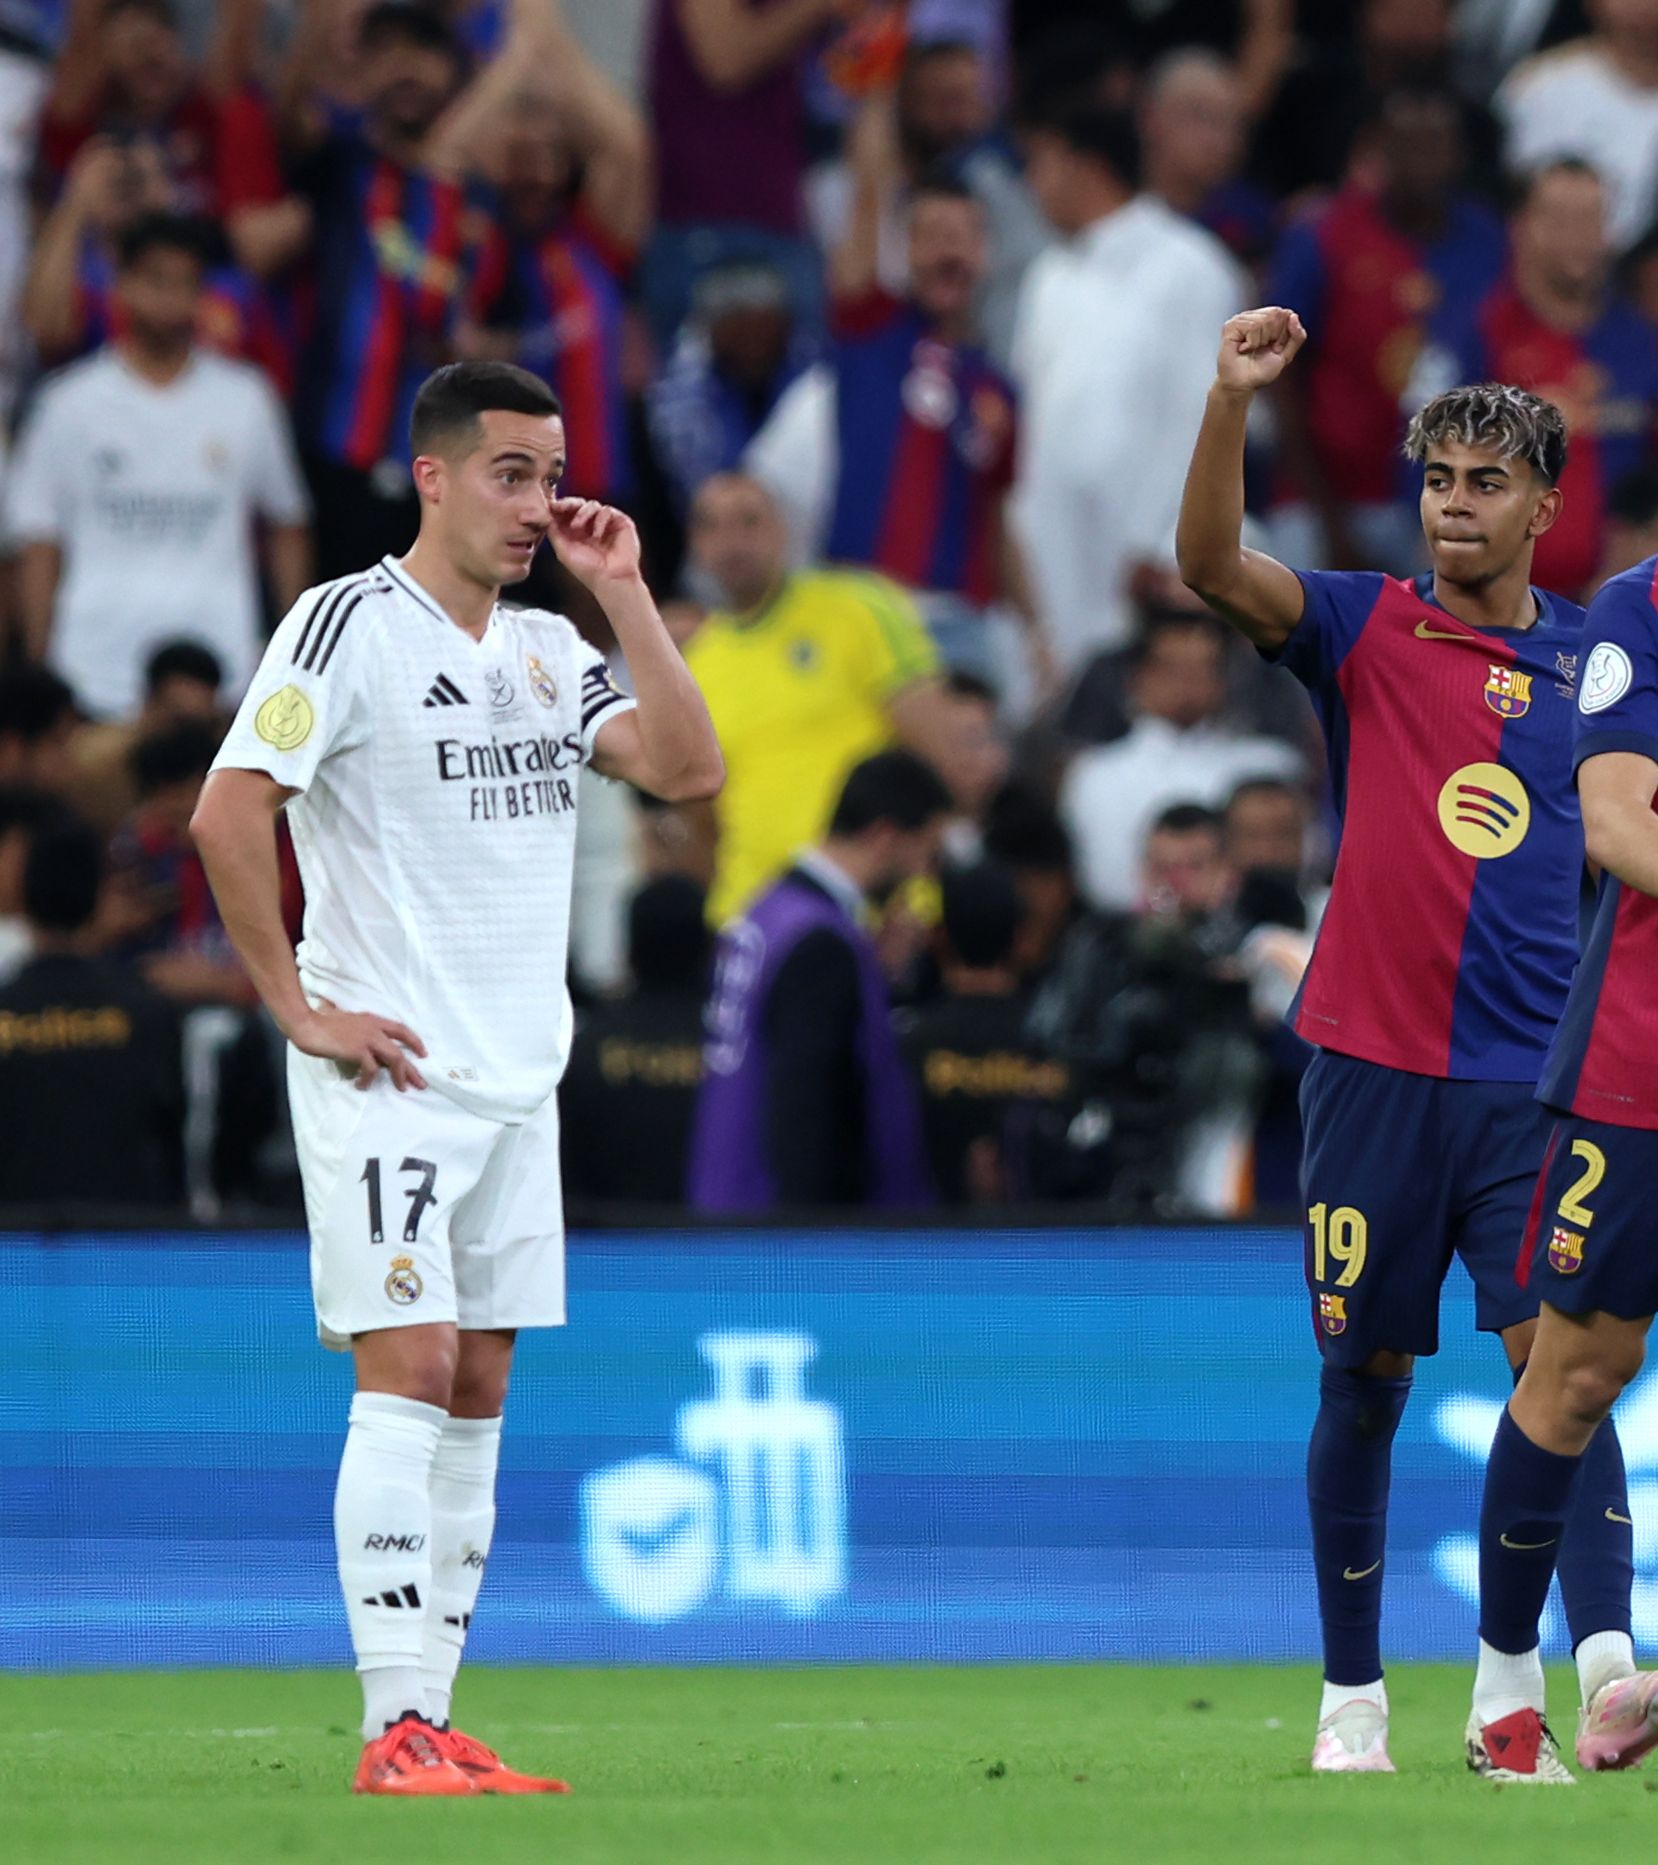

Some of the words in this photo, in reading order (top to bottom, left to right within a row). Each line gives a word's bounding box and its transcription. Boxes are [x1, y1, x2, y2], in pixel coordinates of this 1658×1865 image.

[435, 732, 584, 781] Emirates
[470, 789, 497, 822] FLY
[504, 778, 575, 819] BETTER
[359, 1156, 438, 1244] 17
[1557, 1139, 1606, 1228] 2
[1309, 1202, 1367, 1287] 19
